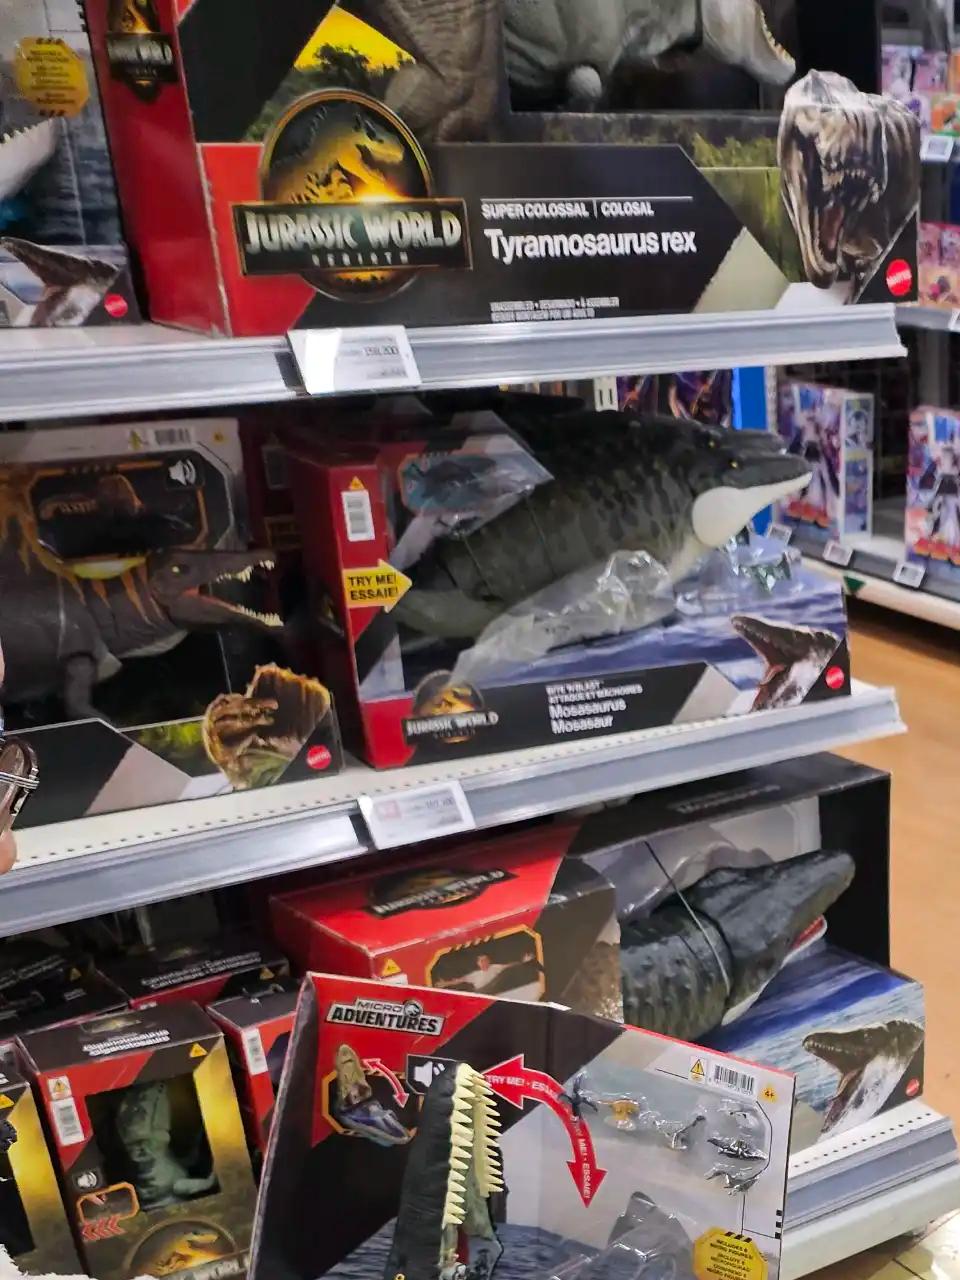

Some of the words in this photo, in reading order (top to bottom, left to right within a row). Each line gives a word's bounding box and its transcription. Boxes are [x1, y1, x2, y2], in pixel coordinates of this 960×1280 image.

[481, 203, 524, 219] SUPER
[525, 202, 589, 218] COLOSSAL
[601, 201, 654, 217] COLOSAL
[245, 210, 358, 254] JURASSIC
[361, 210, 462, 249] WORLD
[484, 229, 659, 265] Tyrannosaurus
[661, 231, 697, 254] rex
[349, 575, 372, 587] TRY
[375, 572, 397, 585] ME!
[350, 587, 398, 601] ESSAIE!
[549, 698, 626, 719] Mosasaurus
[357, 1001, 402, 1013] MICRO
[331, 1006, 438, 1033] ADVENTURES
[486, 1074, 505, 1085] TRY
[506, 1075, 525, 1087] ME!
